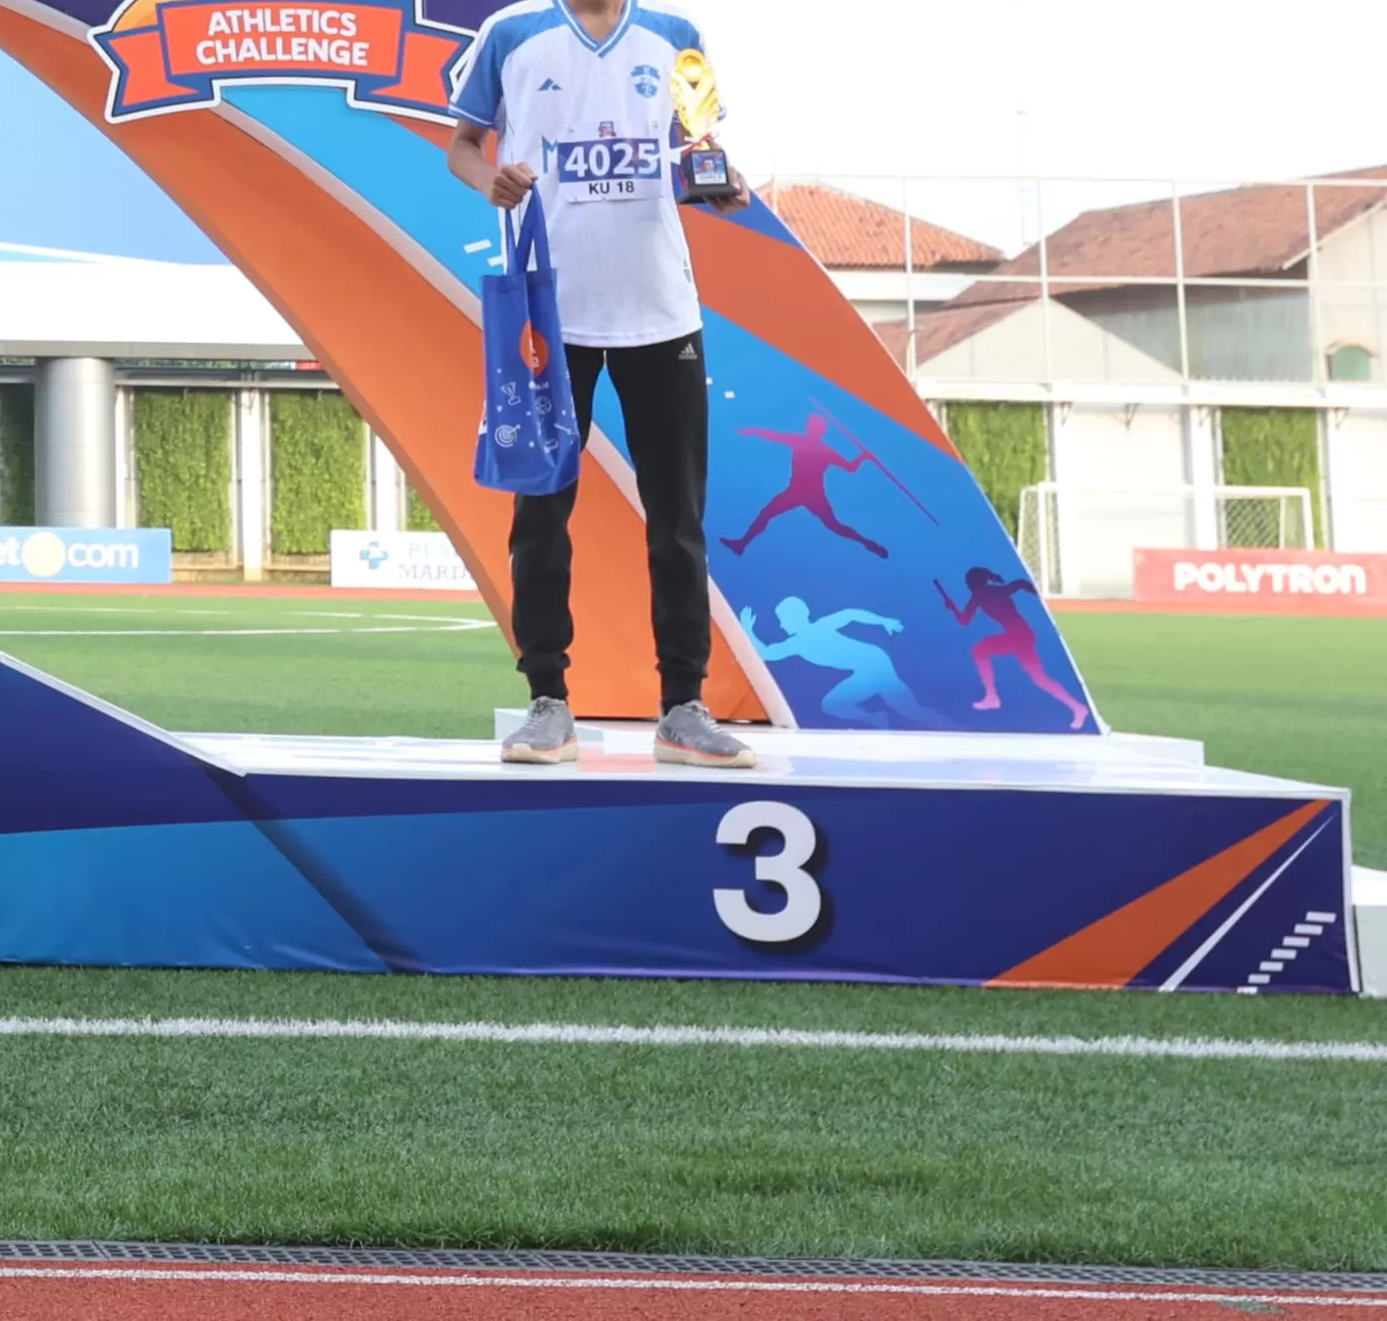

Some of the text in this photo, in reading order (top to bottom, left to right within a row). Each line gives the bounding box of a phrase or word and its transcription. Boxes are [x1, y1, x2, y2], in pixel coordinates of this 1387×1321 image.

[207, 8, 357, 38] ATHLETICS
[195, 38, 370, 67] CHALLENGE
[564, 142, 659, 178] 4025
[588, 180, 635, 195] KU 18
[398, 563, 466, 580] MARD
[713, 800, 822, 943] 3
